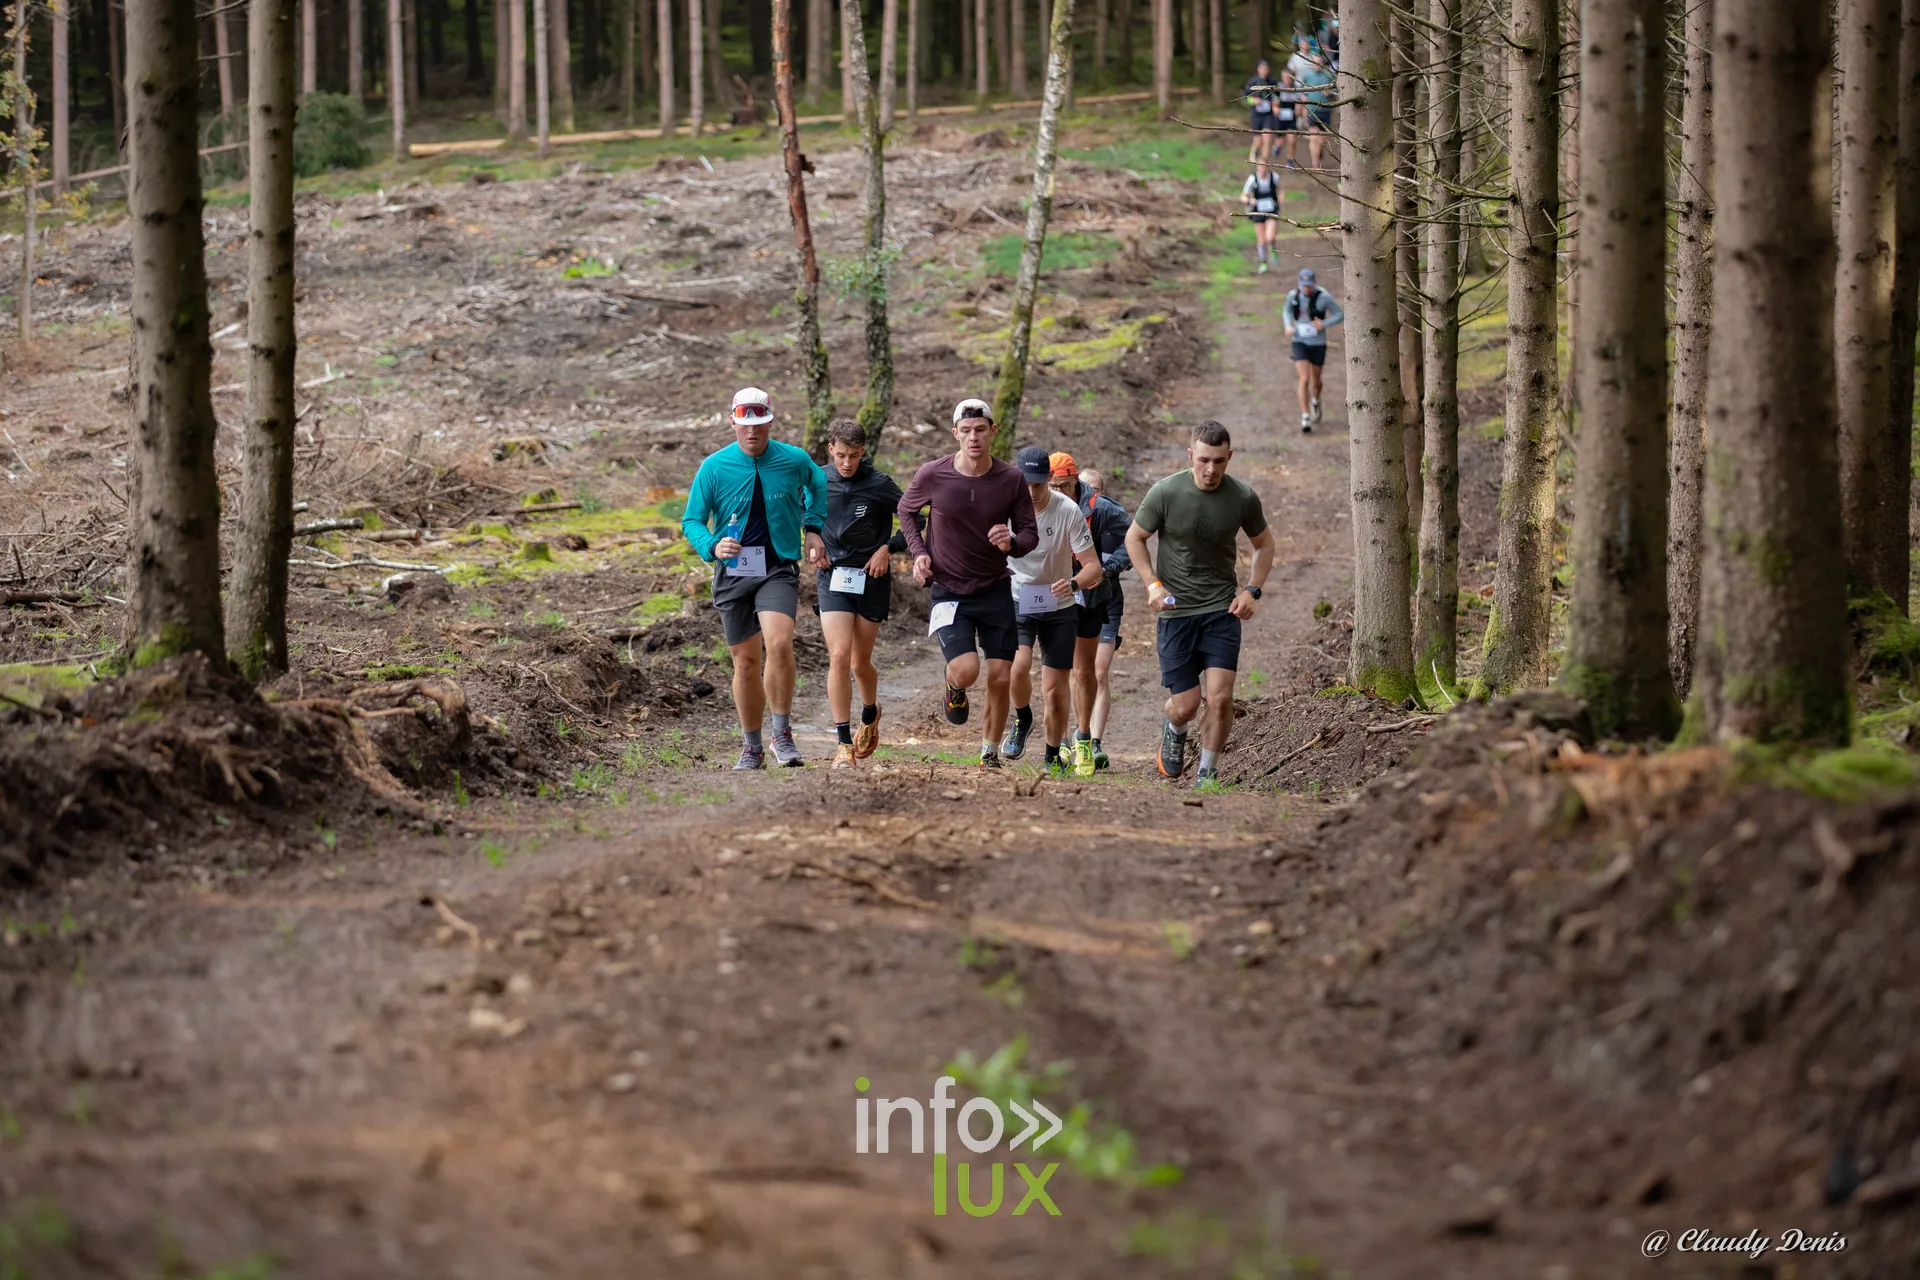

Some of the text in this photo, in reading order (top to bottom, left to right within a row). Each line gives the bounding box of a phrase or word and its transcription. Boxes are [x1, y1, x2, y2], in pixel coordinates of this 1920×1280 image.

[741, 557, 748, 566] 3
[843, 576, 853, 584] 28
[1033, 595, 1044, 603] 76
